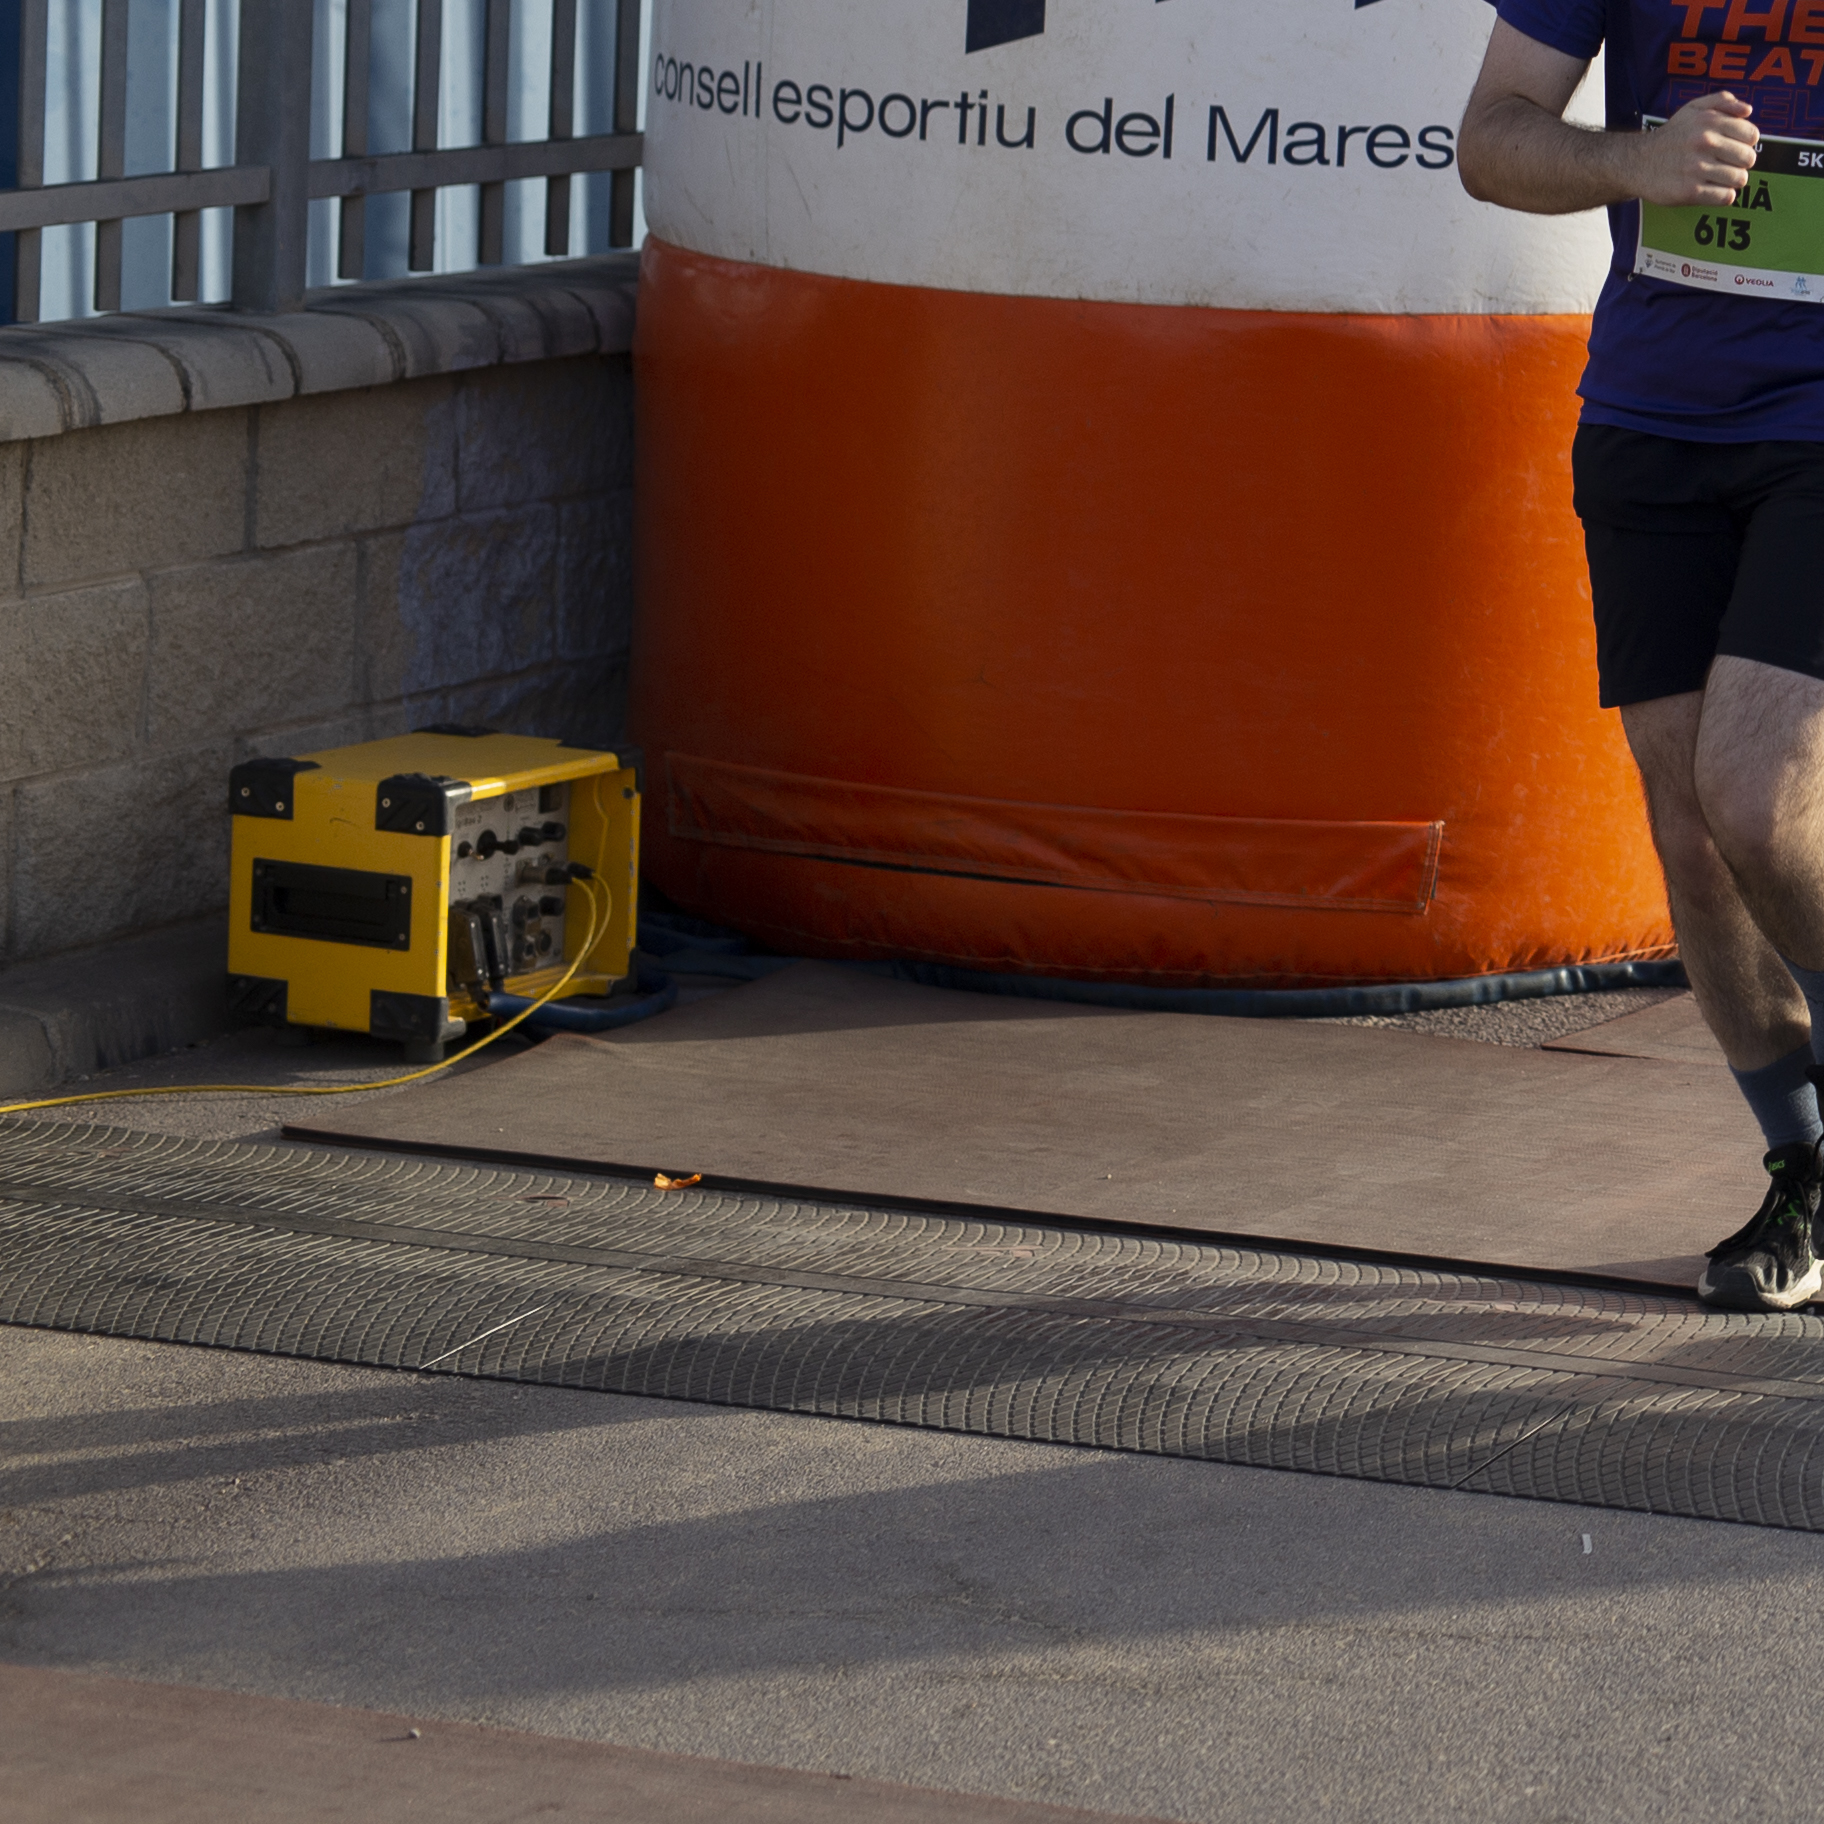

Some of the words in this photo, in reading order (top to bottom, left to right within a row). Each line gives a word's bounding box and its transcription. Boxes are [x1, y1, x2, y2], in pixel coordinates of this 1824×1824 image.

[654, 51, 763, 119] consell
[772, 79, 1037, 150] esportiu
[1065, 92, 1175, 159] del
[1206, 104, 1456, 170] Mares
[1694, 214, 1751, 251] 613
[1745, 278, 1774, 287] VEOLIA
